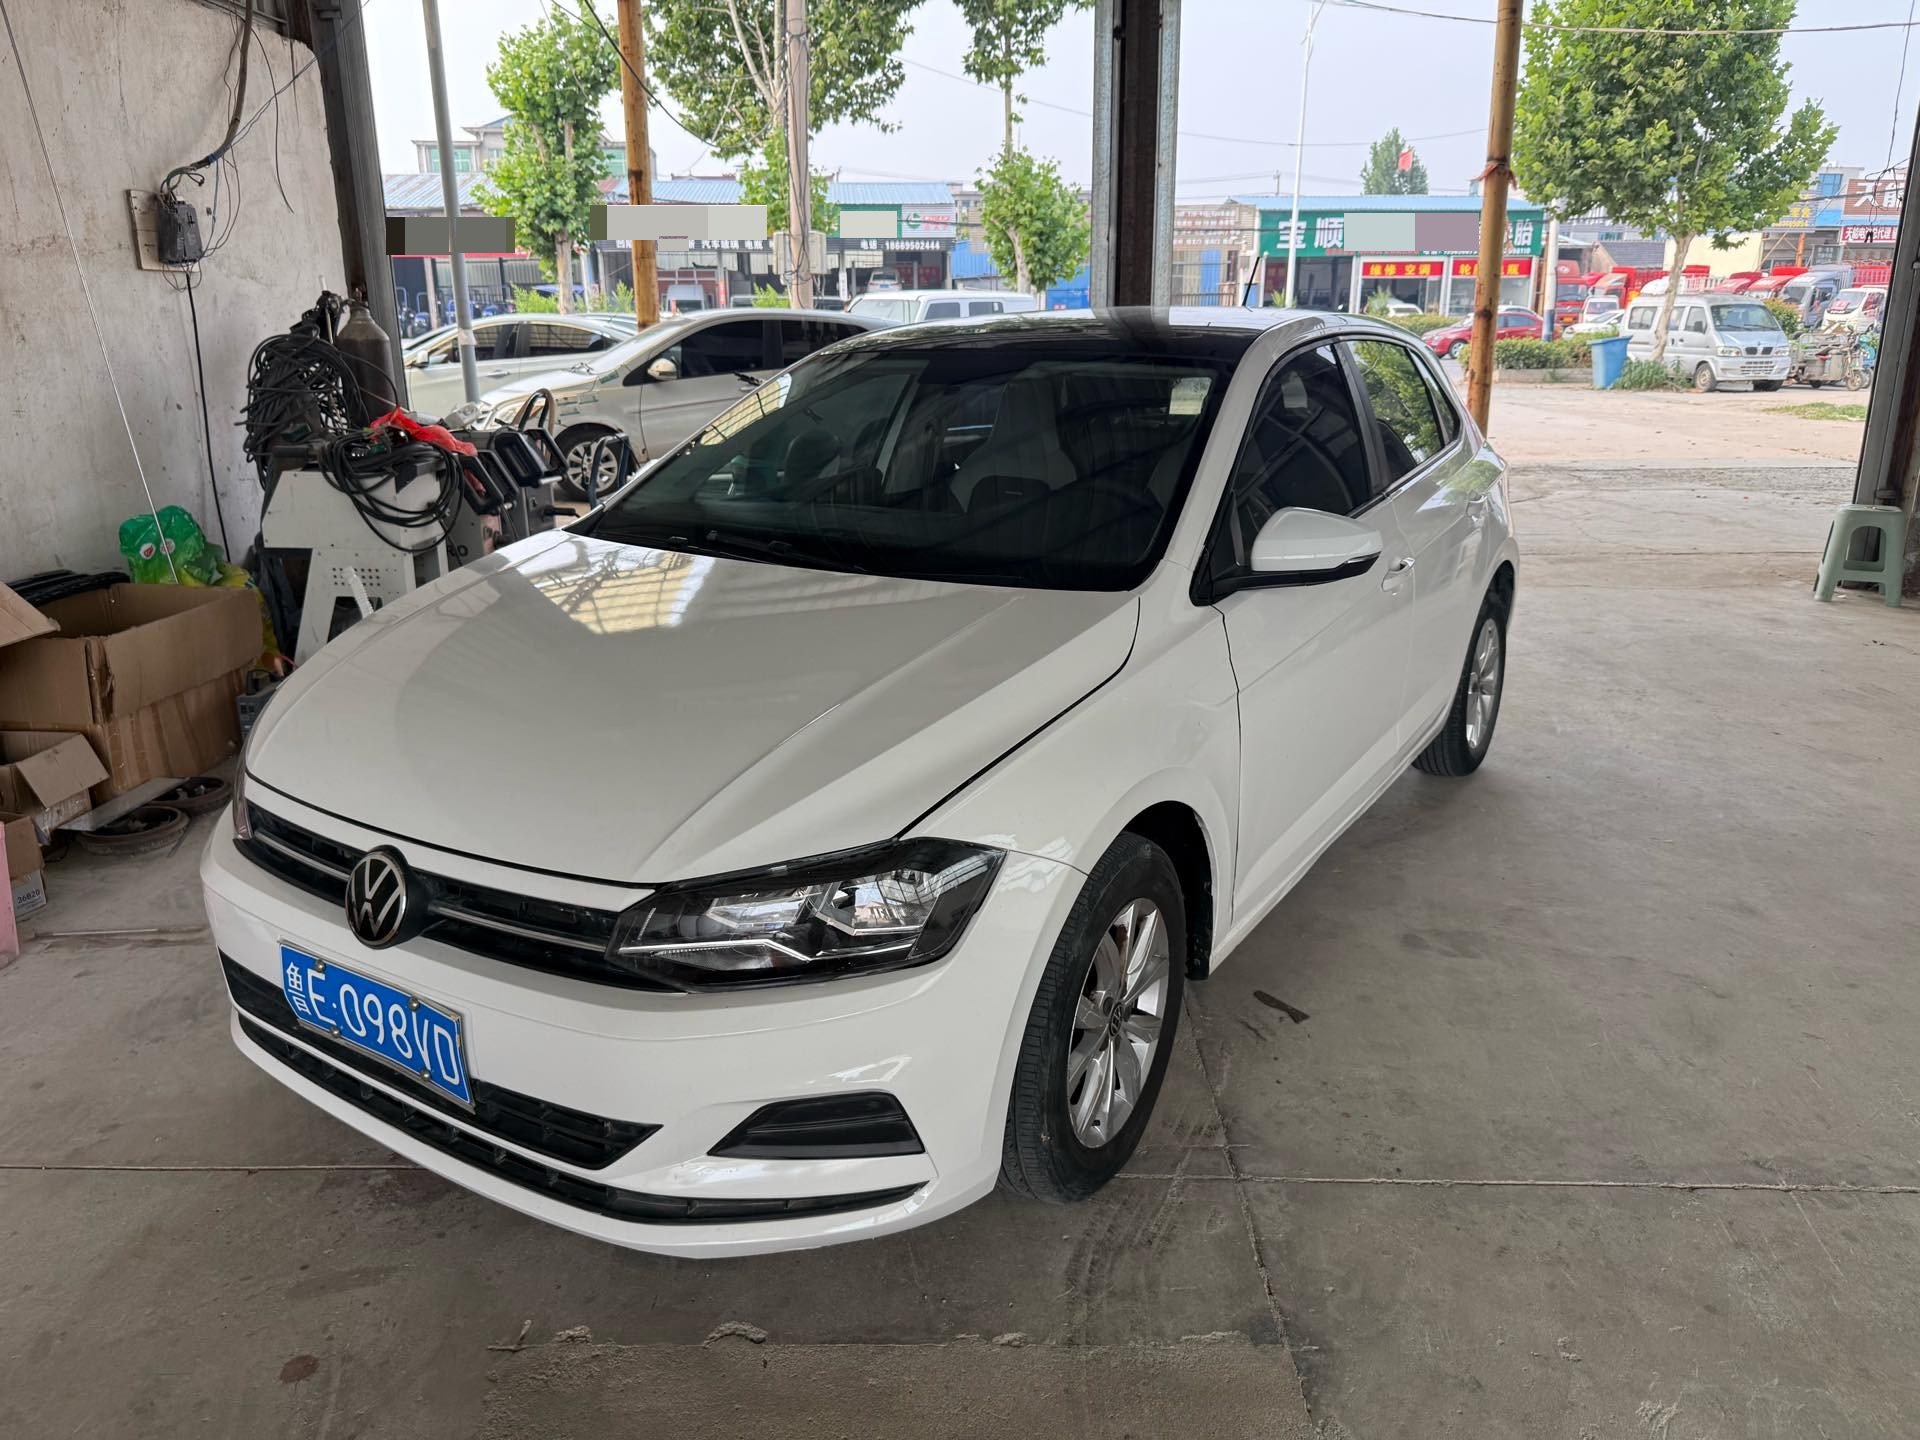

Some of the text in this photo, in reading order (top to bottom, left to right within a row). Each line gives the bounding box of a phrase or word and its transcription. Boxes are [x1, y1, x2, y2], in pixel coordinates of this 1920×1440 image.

[1277, 217, 1344, 249] 宝顺
[1369, 263, 1432, 276] 维修 空调
